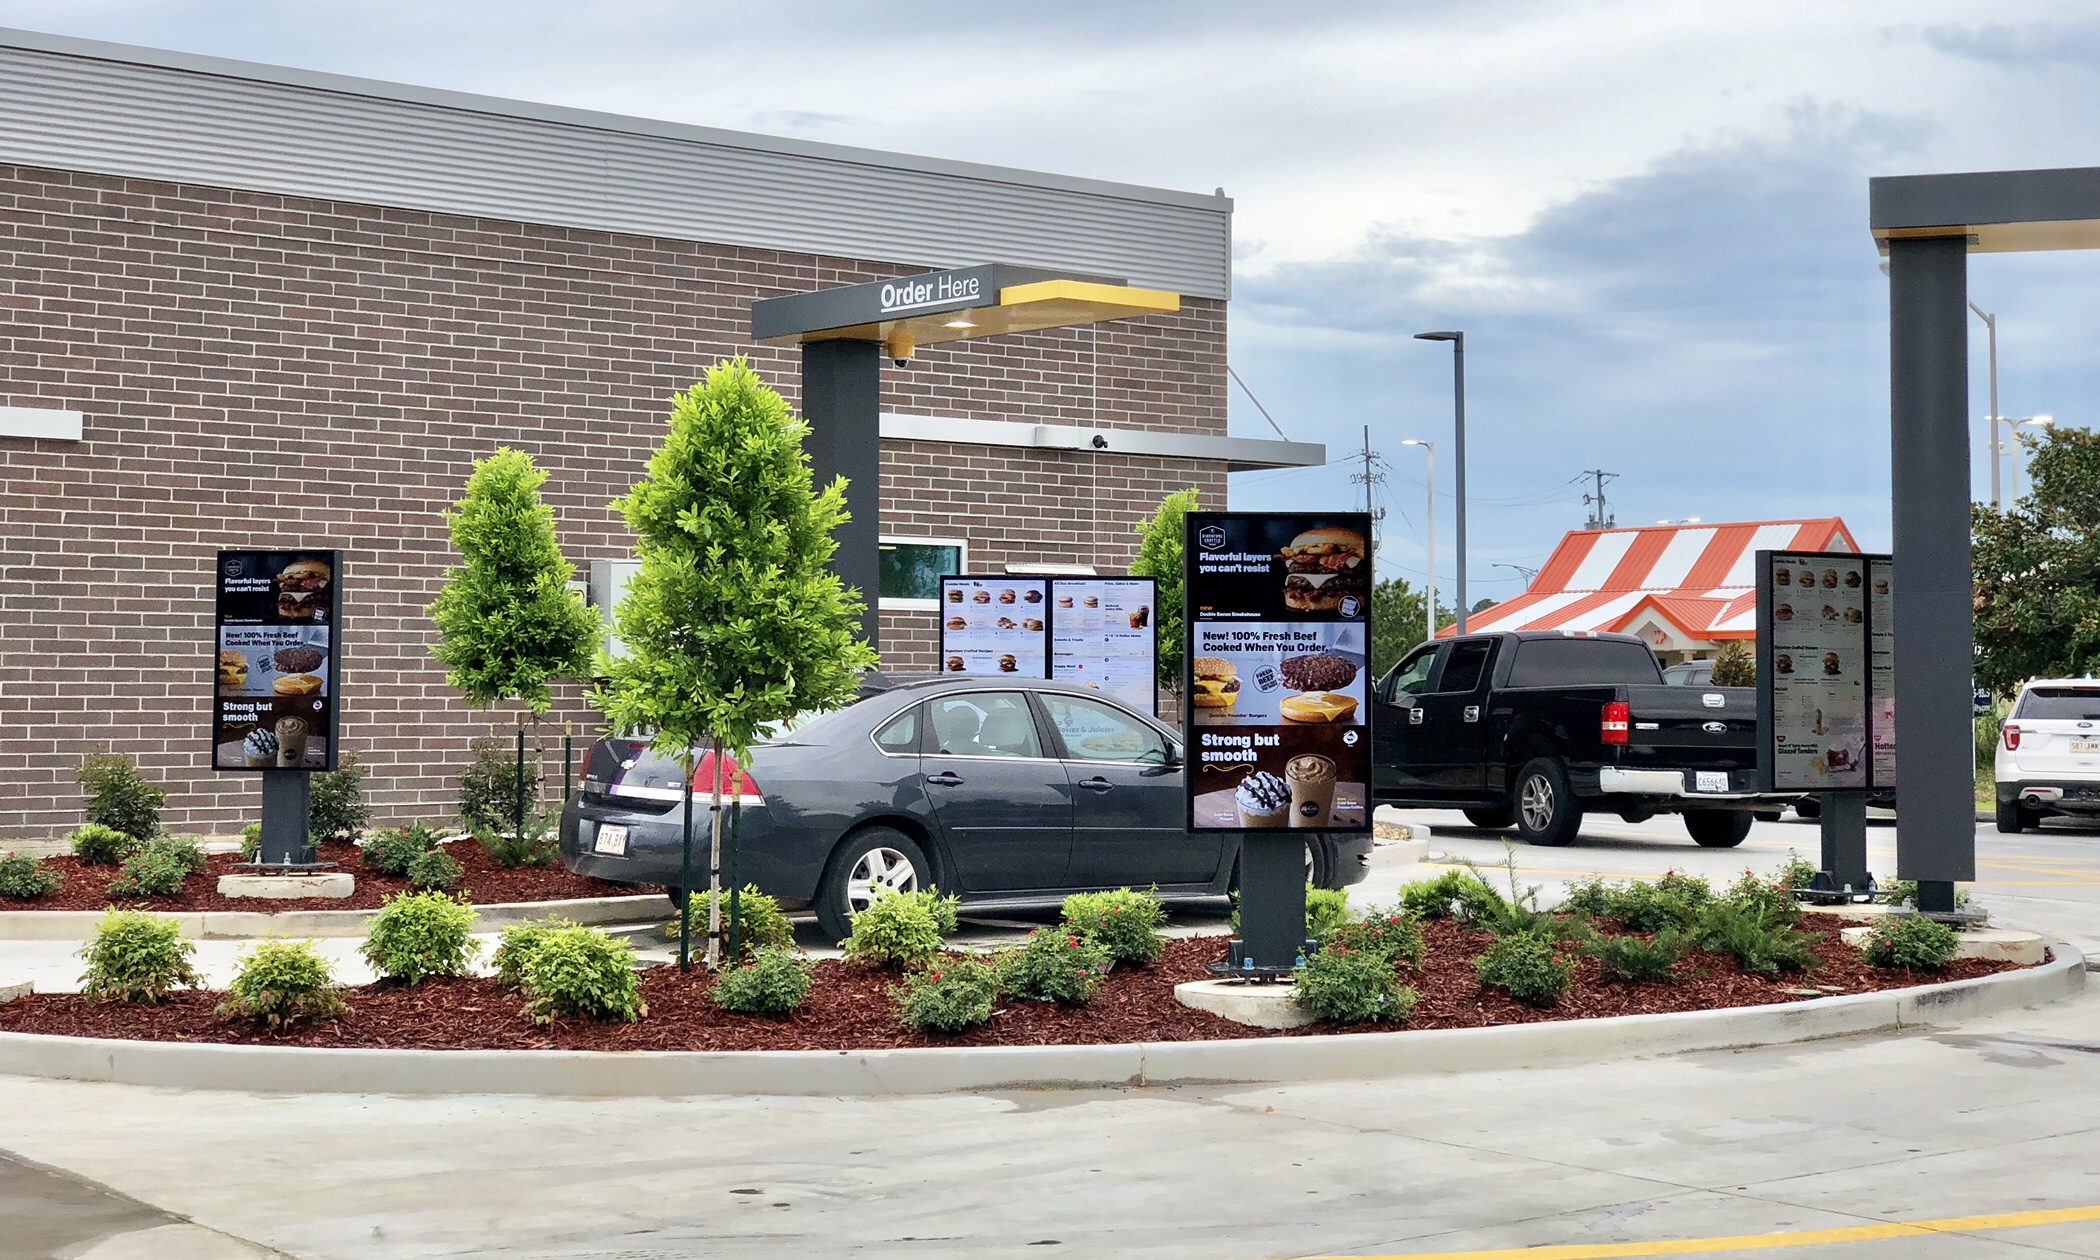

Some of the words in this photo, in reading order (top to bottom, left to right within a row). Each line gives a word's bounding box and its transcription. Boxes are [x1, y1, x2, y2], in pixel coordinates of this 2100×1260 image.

[881, 281, 933, 307] Order
[939, 275, 979, 299] Here
[1200, 552, 1242, 561] Flavorful
[1243, 552, 1272, 562] layers
[1200, 566, 1216, 574] you
[1218, 564, 1242, 572] can't
[1243, 564, 1270, 572] resist
[1203, 632, 1229, 640] New!
[1232, 632, 1260, 640] 100%
[1263, 632, 1291, 640] Fresh
[1294, 632, 1317, 640] Beef
[1203, 643, 1242, 652] Cooked
[1245, 643, 1274, 652] When
[1276, 643, 1295, 652] You
[1256, 668, 1273, 678] FRESH
[1258, 673, 1274, 685] BEEF
[223, 702, 254, 712] Strong
[256, 702, 272, 710] but
[222, 713, 258, 721] smooth
[1202, 733, 1251, 748] Strong
[1254, 733, 1280, 746] but
[1202, 749, 1257, 762] smooth
